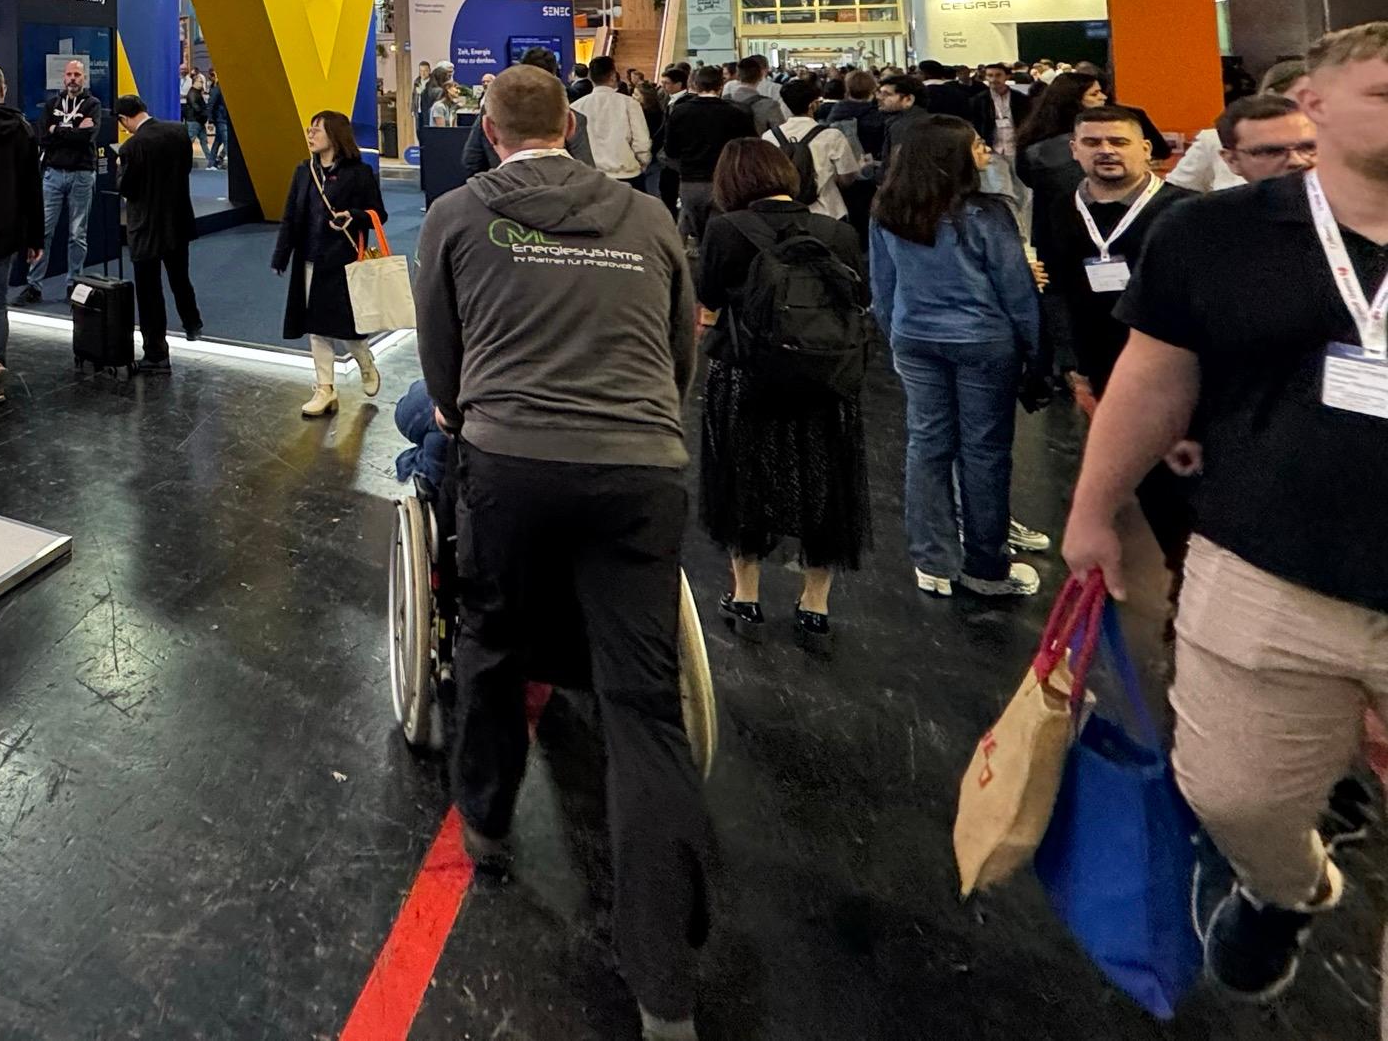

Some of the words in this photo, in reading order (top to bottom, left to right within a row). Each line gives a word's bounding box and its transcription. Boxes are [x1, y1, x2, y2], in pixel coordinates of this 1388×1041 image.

[941, 0, 1011, 10] CEGASA
[542, 6, 570, 17] SENEC
[470, 48, 491, 57] Energie
[512, 243, 643, 262] Energiesysteme
[528, 256, 566, 265] Partner
